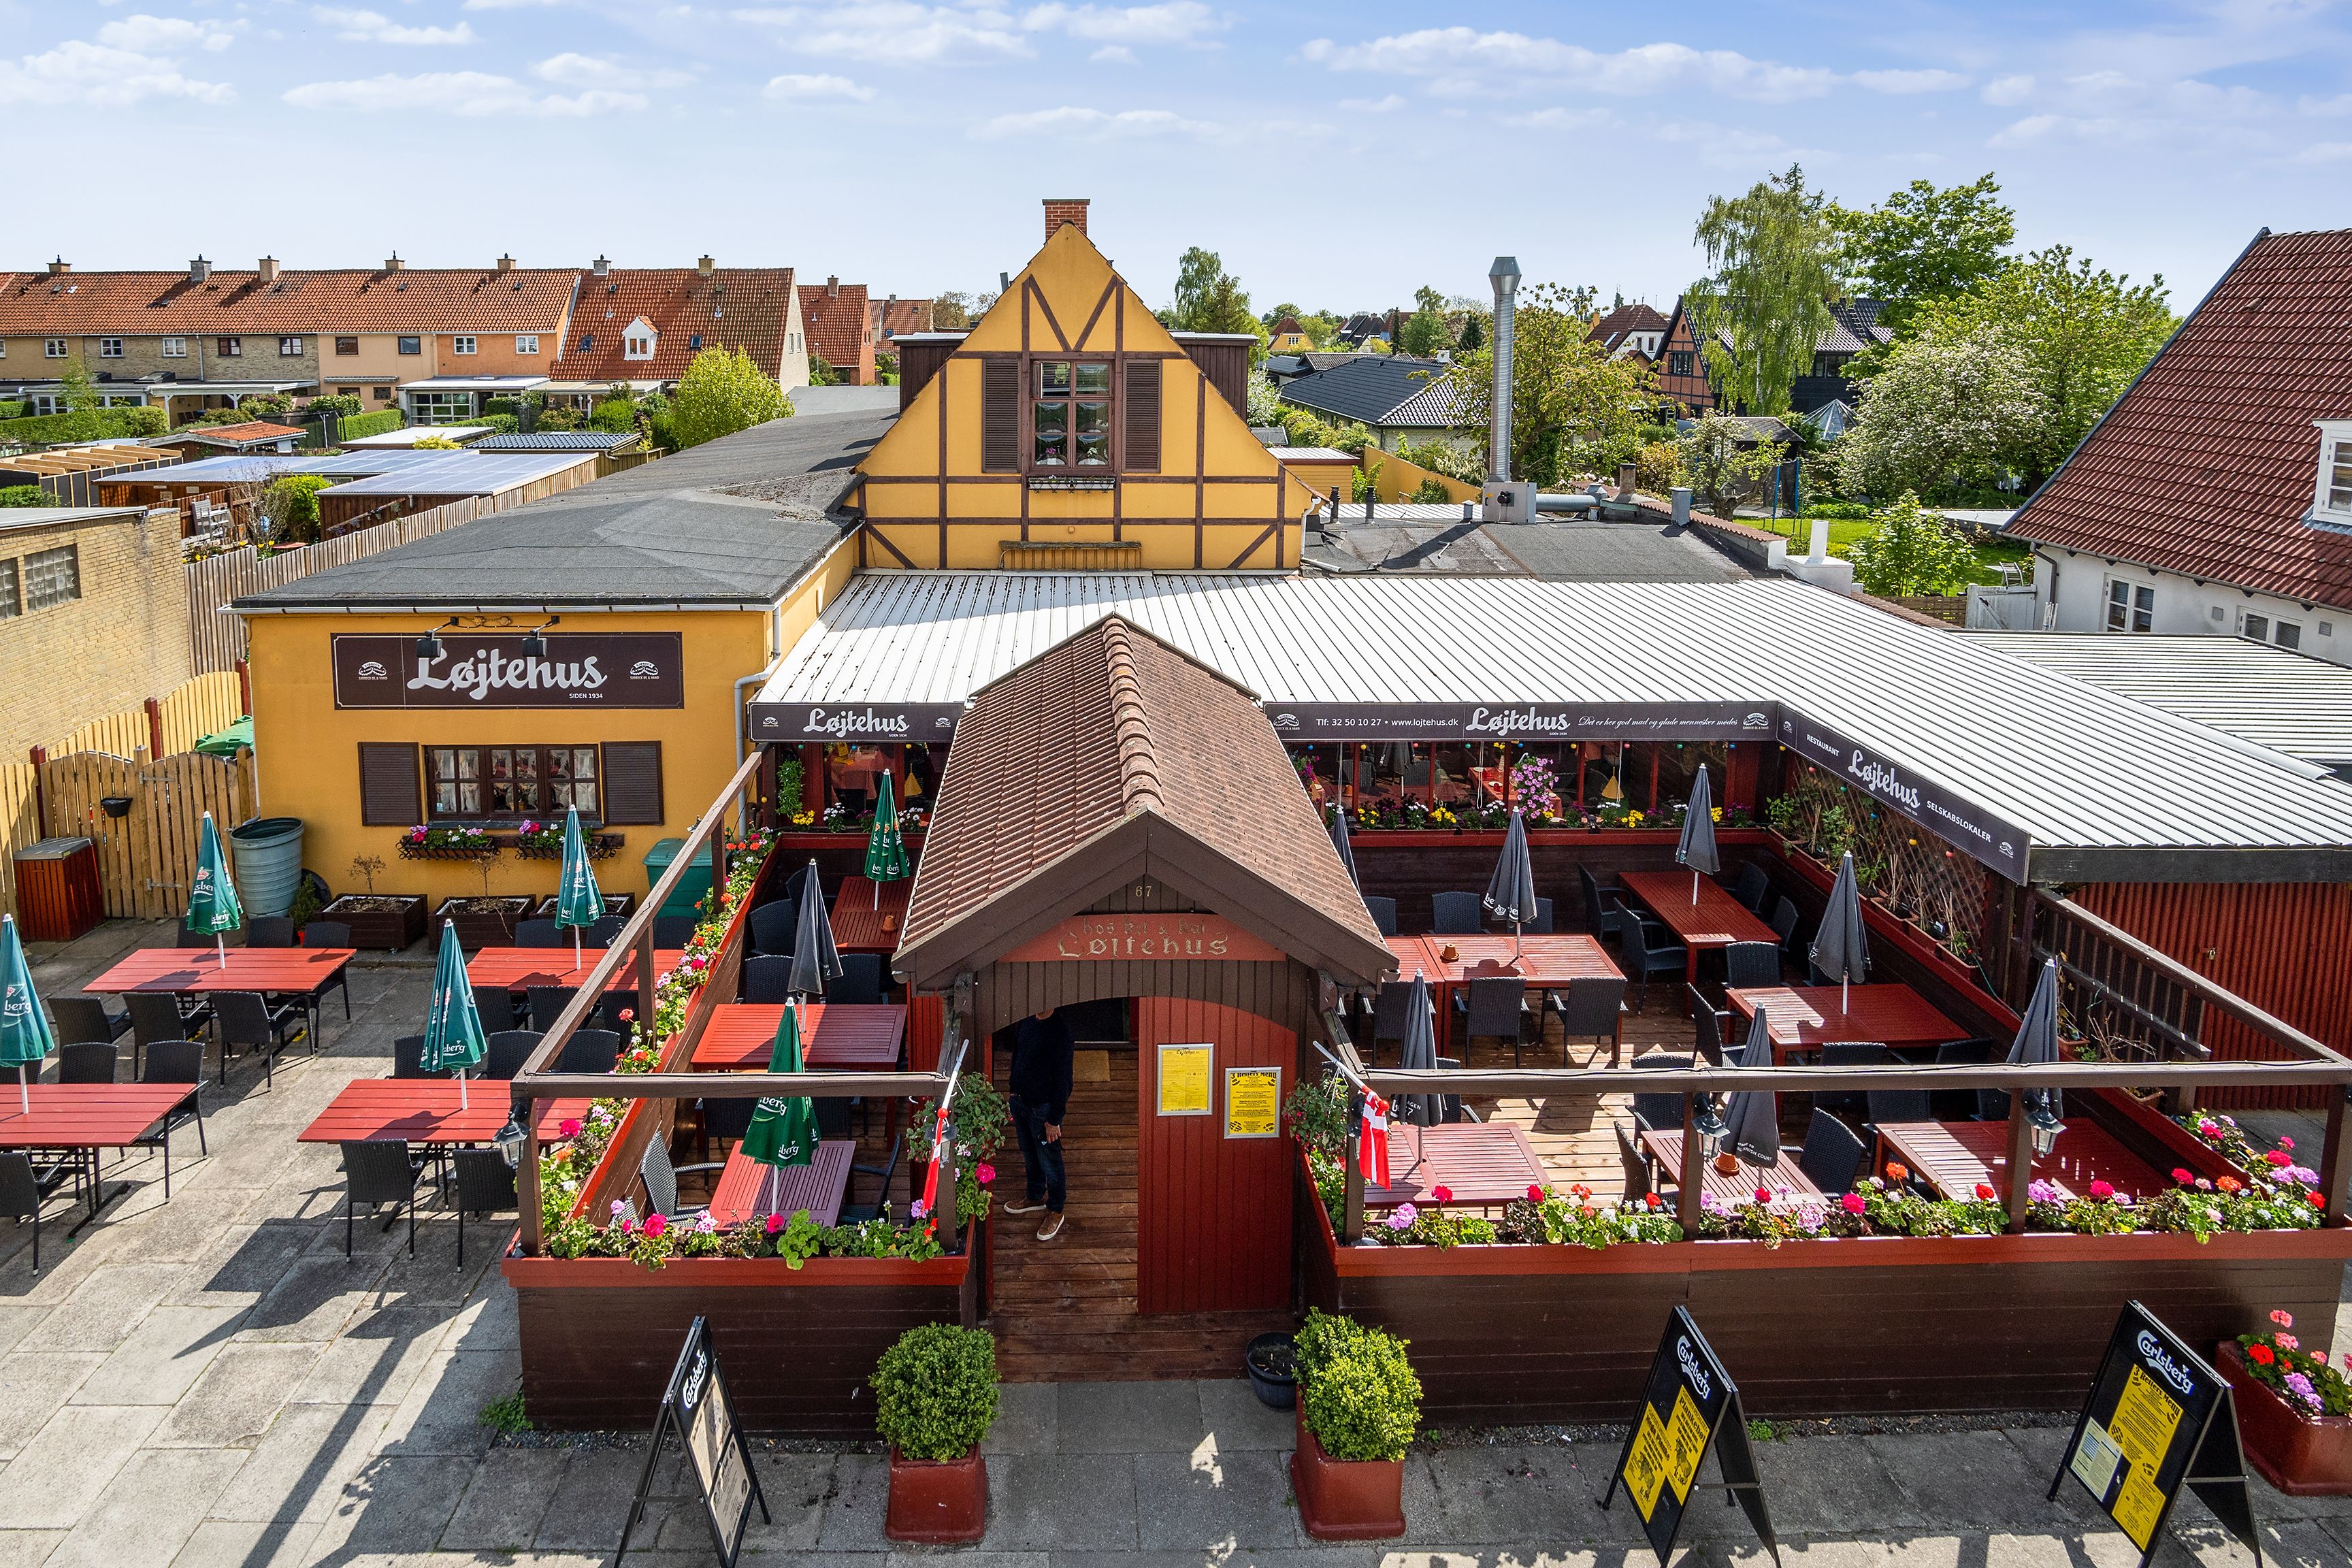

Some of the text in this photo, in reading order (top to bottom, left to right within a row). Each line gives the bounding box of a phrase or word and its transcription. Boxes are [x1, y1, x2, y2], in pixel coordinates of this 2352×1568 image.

[407, 648, 608, 700] Løjtehus
[803, 708, 910, 738] Løjtehus
[1391, 719, 1458, 728] www.lojtehus.dk
[1465, 707, 1571, 736] Løjtehus
[1578, 716, 1595, 725] Det
[1614, 718, 1632, 729] god
[1648, 721, 1658, 729] og
[1656, 718, 1678, 729] glade
[1807, 734, 1839, 756] RESTAURANT
[1848, 749, 1921, 808] Løjtehus
[1927, 800, 1991, 843] SELSKABSLOKALER
[1135, 885, 1152, 897] 67
[1058, 931, 1228, 958] Løjtehus
[1678, 1335, 1711, 1400] Carlsberg
[2134, 1367, 2140, 1376] 3
[2138, 1330, 2194, 1394] Carlsberg
[683, 1350, 707, 1409] Carlsberg
